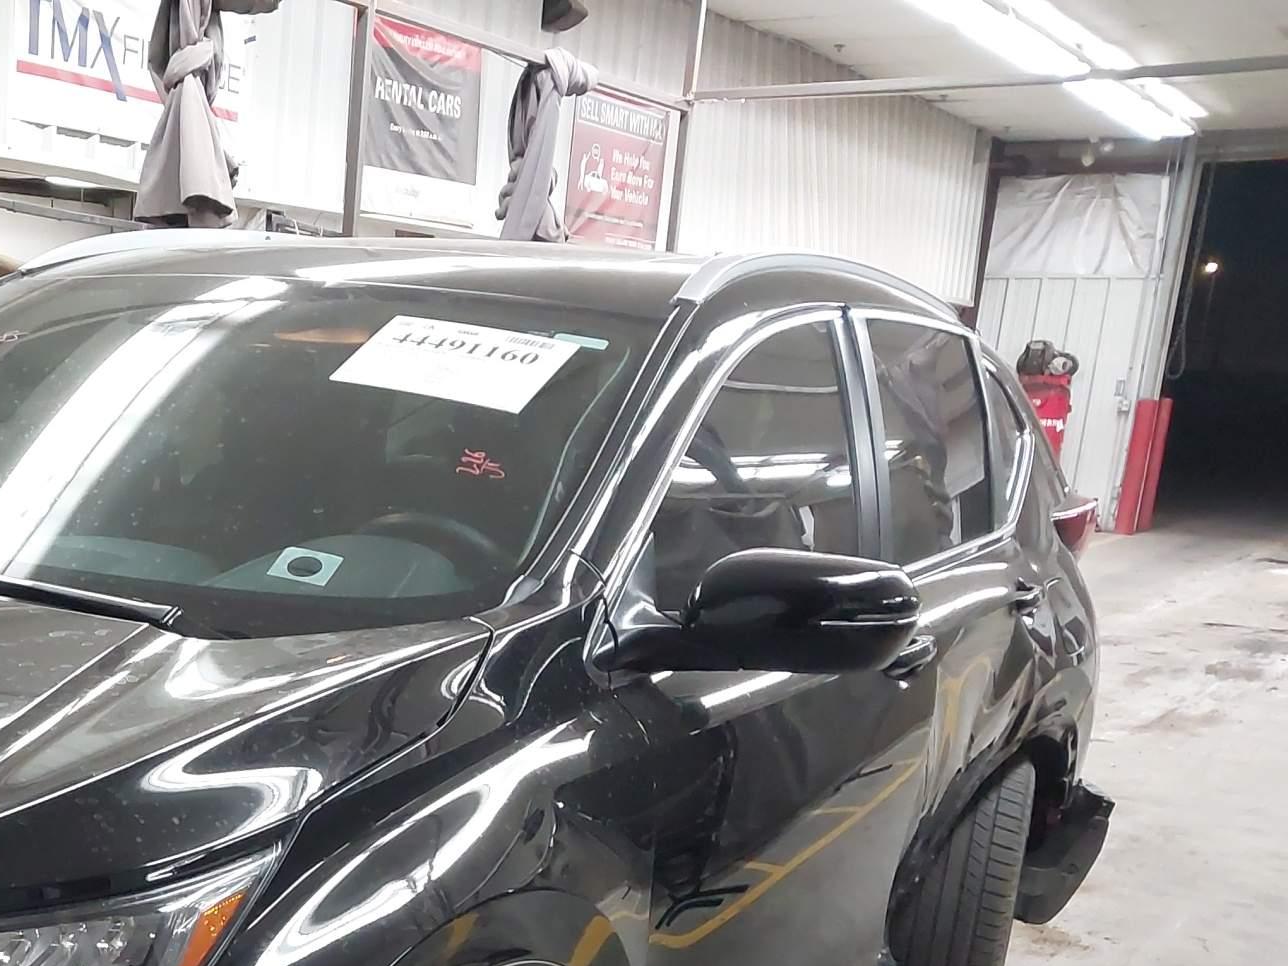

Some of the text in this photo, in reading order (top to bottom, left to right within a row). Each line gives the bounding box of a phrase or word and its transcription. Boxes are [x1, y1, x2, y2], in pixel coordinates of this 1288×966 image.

[375, 76, 424, 110] RENTAL
[428, 90, 462, 119] CARS
[580, 97, 600, 122] SELL
[600, 102, 629, 131] SMART
[629, 110, 650, 137] WITH
[623, 151, 639, 169] Help
[624, 187, 649, 206] Vehicle
[392, 333, 540, 365] 44491160
